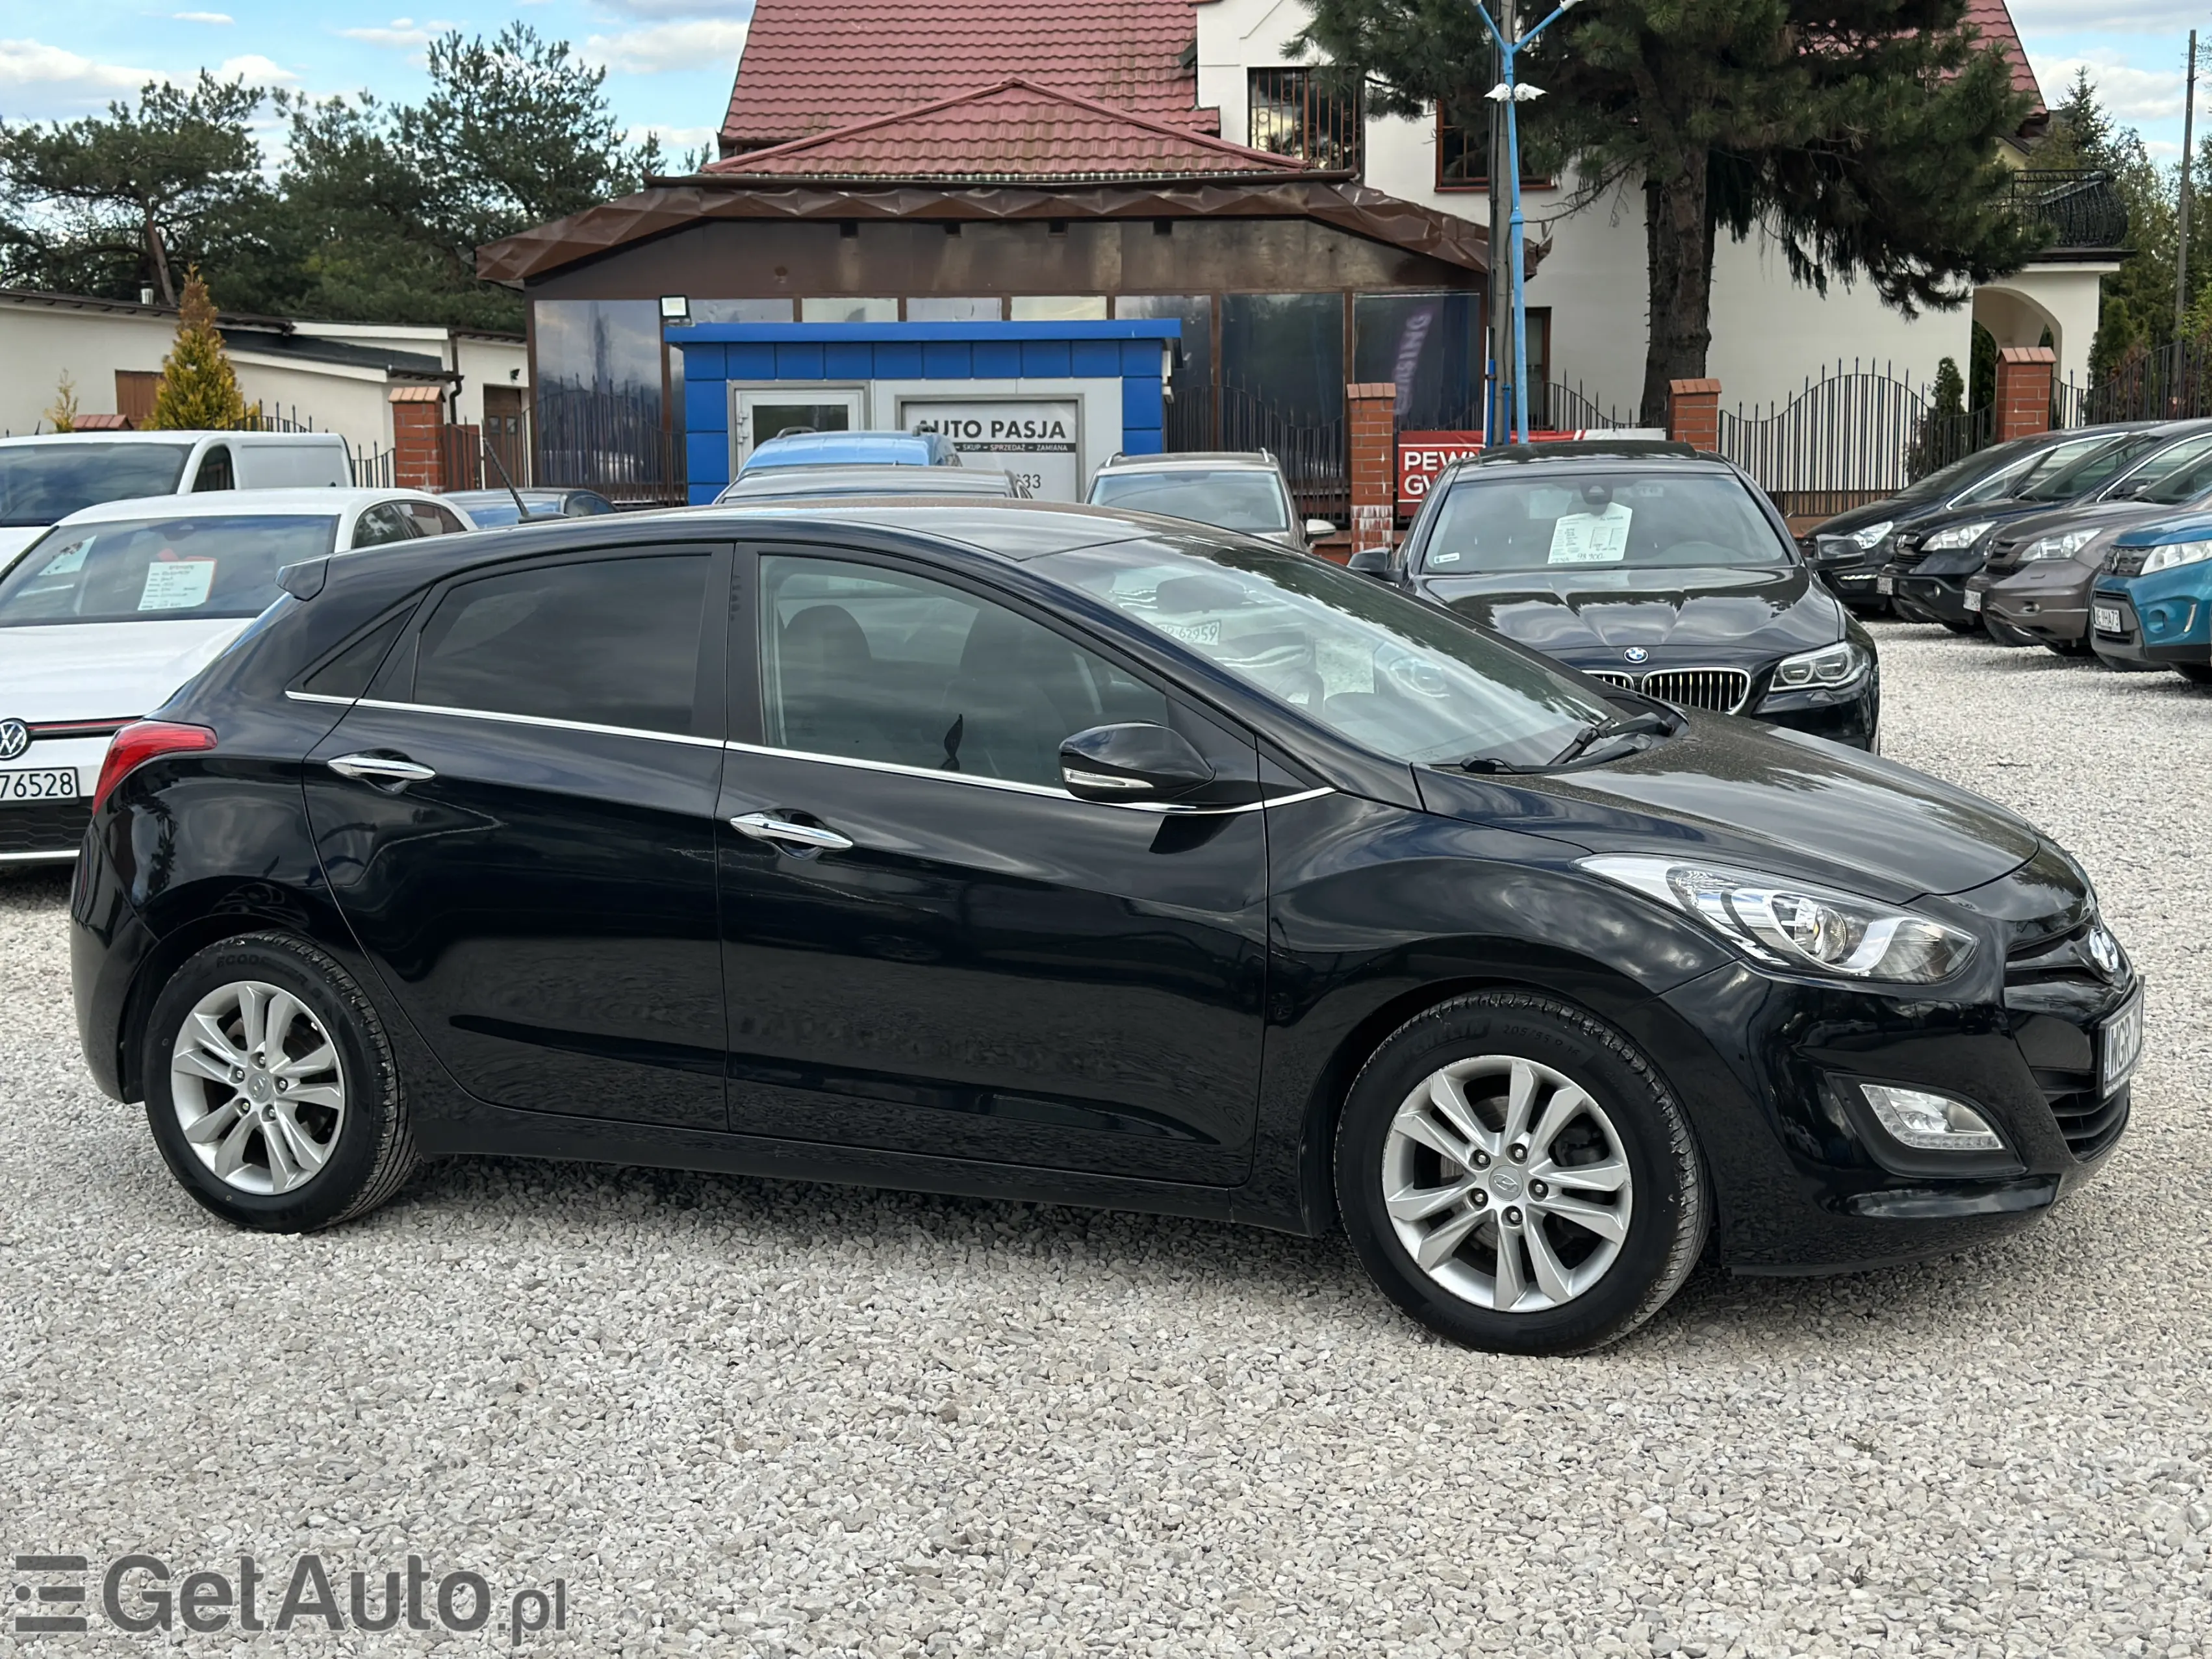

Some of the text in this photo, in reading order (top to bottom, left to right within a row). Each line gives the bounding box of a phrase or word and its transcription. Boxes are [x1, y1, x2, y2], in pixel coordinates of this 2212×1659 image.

[991, 420, 1067, 439] PASJA
[1404, 451, 1477, 471] PEW
[1017, 474, 1041, 489] 33
[0, 772, 73, 798] 76528
[1503, 1024, 1551, 1044] 205/55
[2110, 1015, 2131, 1076] WGR
